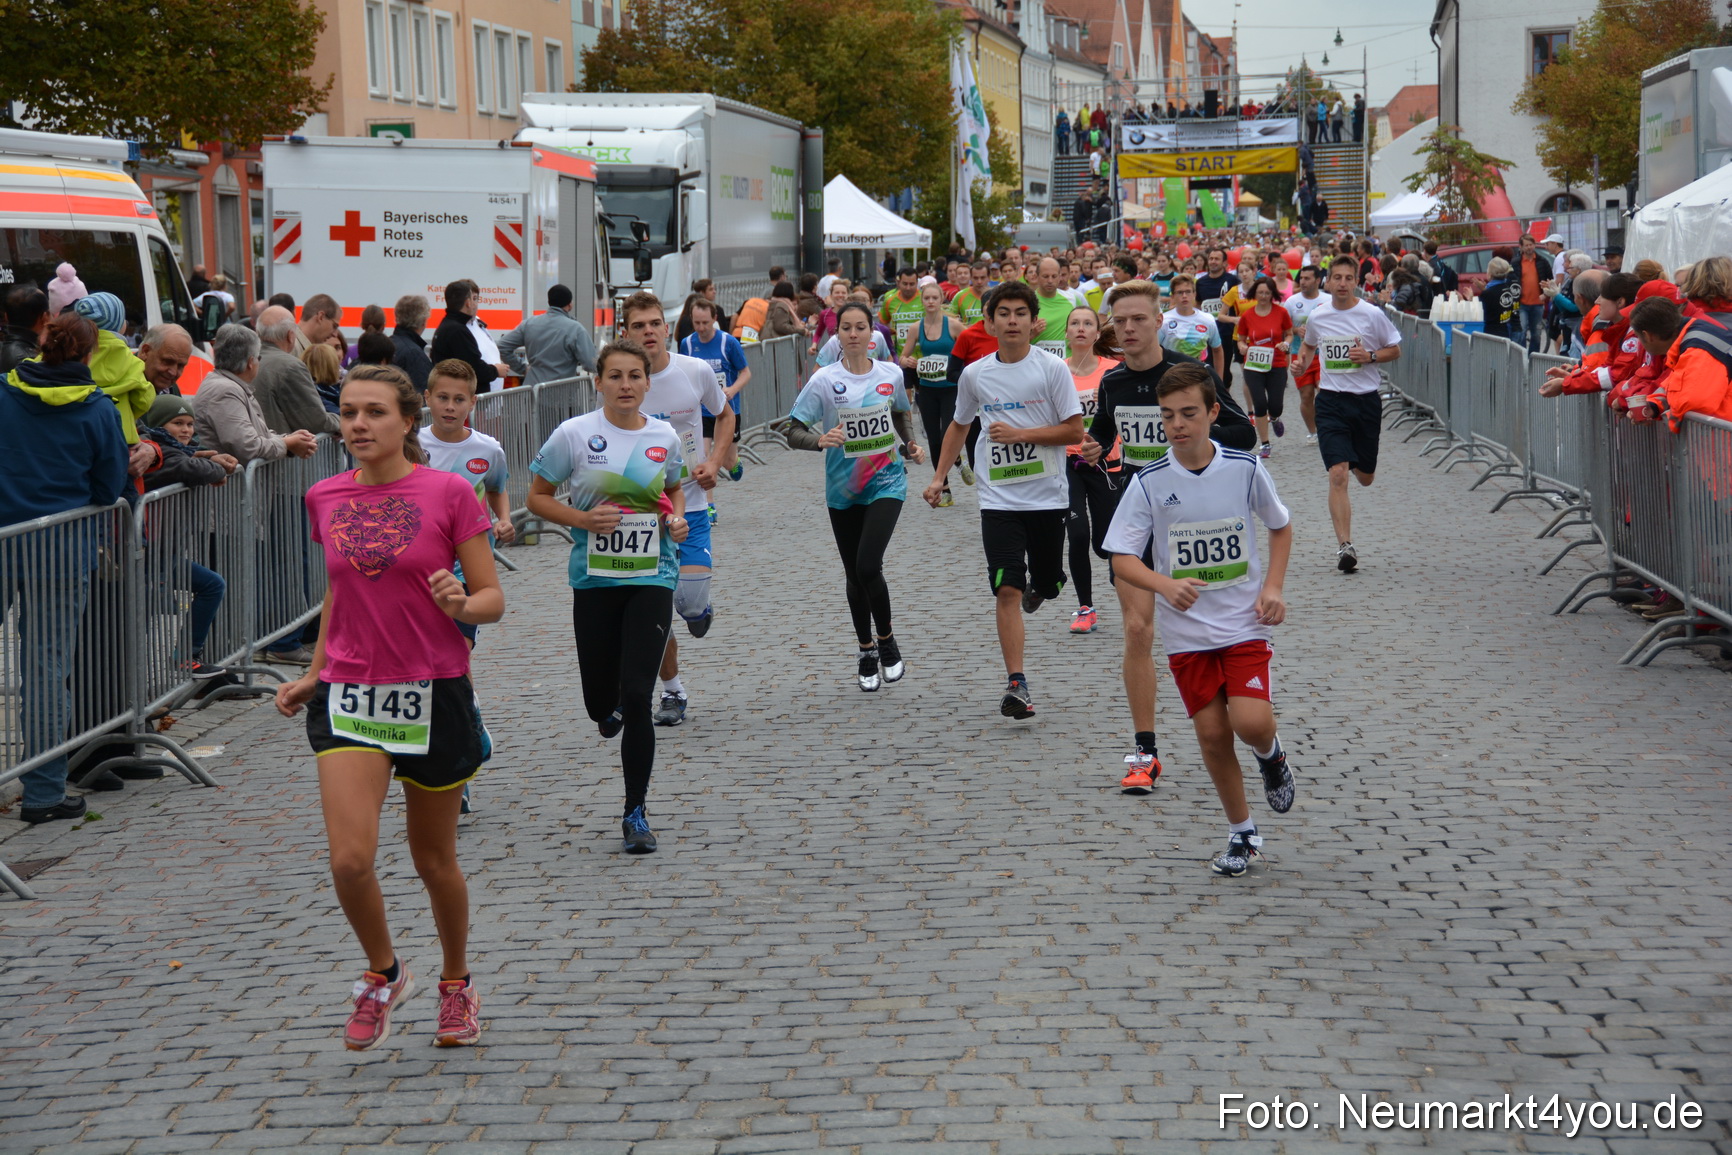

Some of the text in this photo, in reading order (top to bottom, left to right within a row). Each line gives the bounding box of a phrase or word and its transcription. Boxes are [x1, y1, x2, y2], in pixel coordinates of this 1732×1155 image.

[1175, 155, 1236, 171] START
[770, 165, 795, 221] BOCK
[383, 211, 468, 226] Bayerisches
[383, 229, 423, 240] Rotes
[829, 233, 885, 246] Laufsport
[383, 247, 424, 258] Kreuz
[1203, 303, 1223, 313] 5149
[892, 312, 923, 321] BOCK
[1249, 352, 1270, 363] 5101
[1326, 345, 1357, 359] 502
[919, 360, 945, 372] 5002
[858, 408, 884, 418] Neumarkt
[1115, 411, 1162, 419] PARTL Neumarkt
[845, 414, 890, 439] 5026
[1120, 421, 1167, 443] 5148
[991, 443, 1037, 466] 5192
[1129, 448, 1161, 459] Christian
[1002, 467, 1029, 478] Jeffrey
[1163, 499, 1181, 507] adidas
[1169, 525, 1232, 538] PARTL Neumarkt
[595, 530, 654, 554] 5047
[1176, 534, 1242, 567] 5038
[611, 559, 635, 569] Elisa
[1197, 570, 1224, 581] Marc
[1245, 682, 1264, 690] adidas
[340, 683, 422, 721] 5143
[352, 720, 407, 741] Veronika
